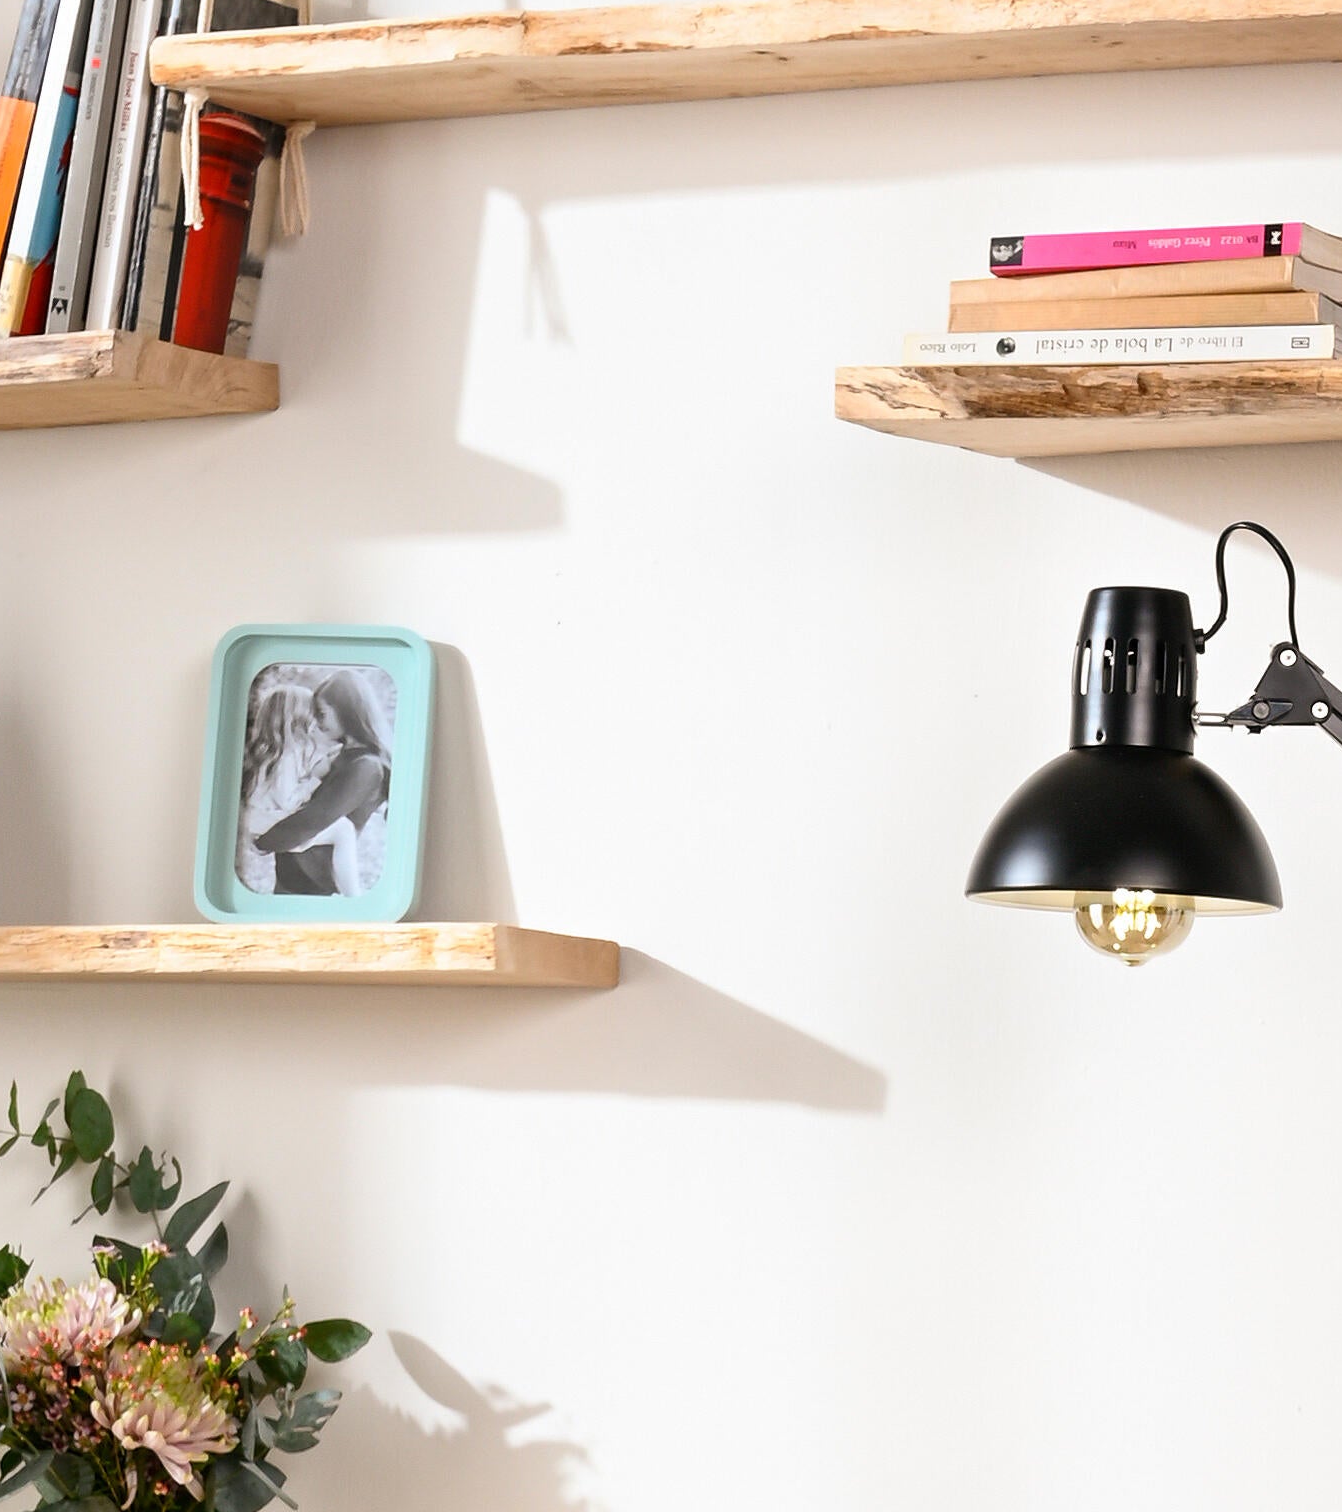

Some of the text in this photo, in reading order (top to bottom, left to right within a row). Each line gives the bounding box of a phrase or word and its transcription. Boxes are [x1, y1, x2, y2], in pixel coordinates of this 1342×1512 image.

[1220, 235, 1244, 246] 0122
[919, 342, 947, 354] Rico
[1035, 337, 1174, 355] La bola de cristal
[1180, 336, 1244, 349] El libro de
